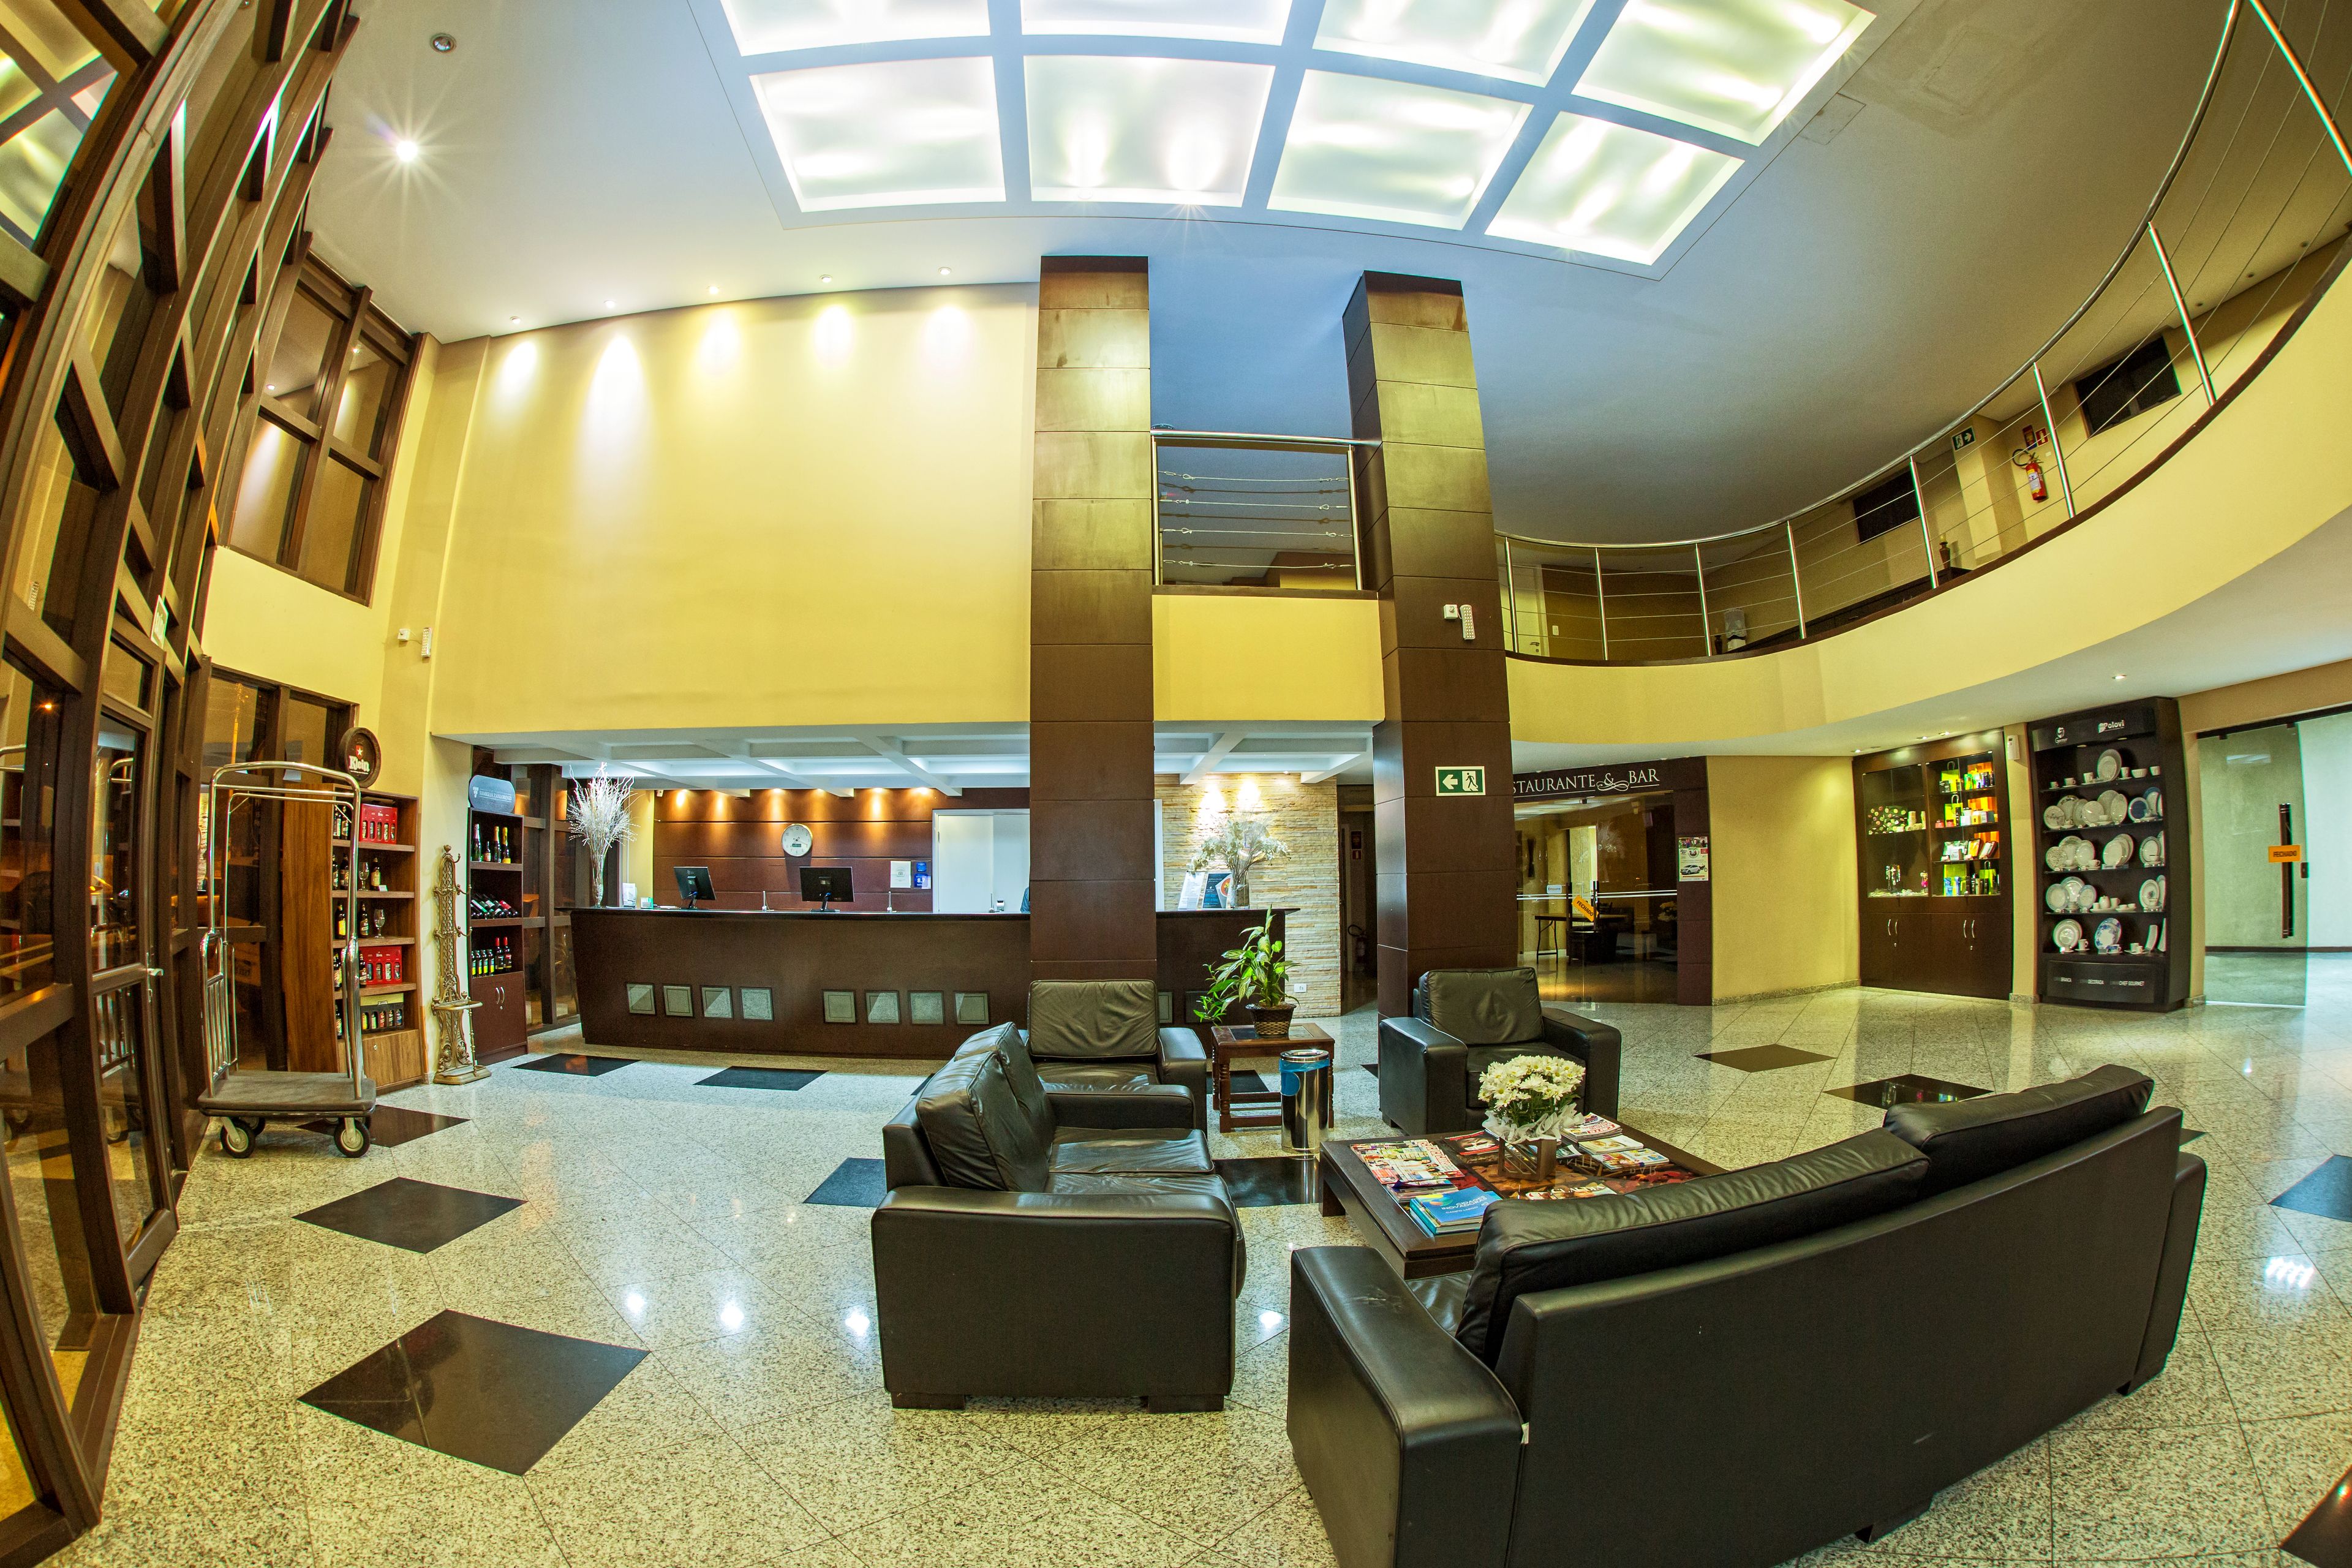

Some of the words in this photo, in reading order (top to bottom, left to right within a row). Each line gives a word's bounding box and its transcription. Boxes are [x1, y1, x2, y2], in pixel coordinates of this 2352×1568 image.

[2102, 720, 2124, 729] Polovi
[349, 755, 370, 772] Klein
[1628, 768, 1660, 785] BAR
[1577, 900, 1594, 917] FECHADO
[1551, 1183, 1605, 1193] CLAUDIA
[1441, 1196, 1488, 1210] INOVADORAS
[1455, 1195, 1487, 1206] CIDADES
